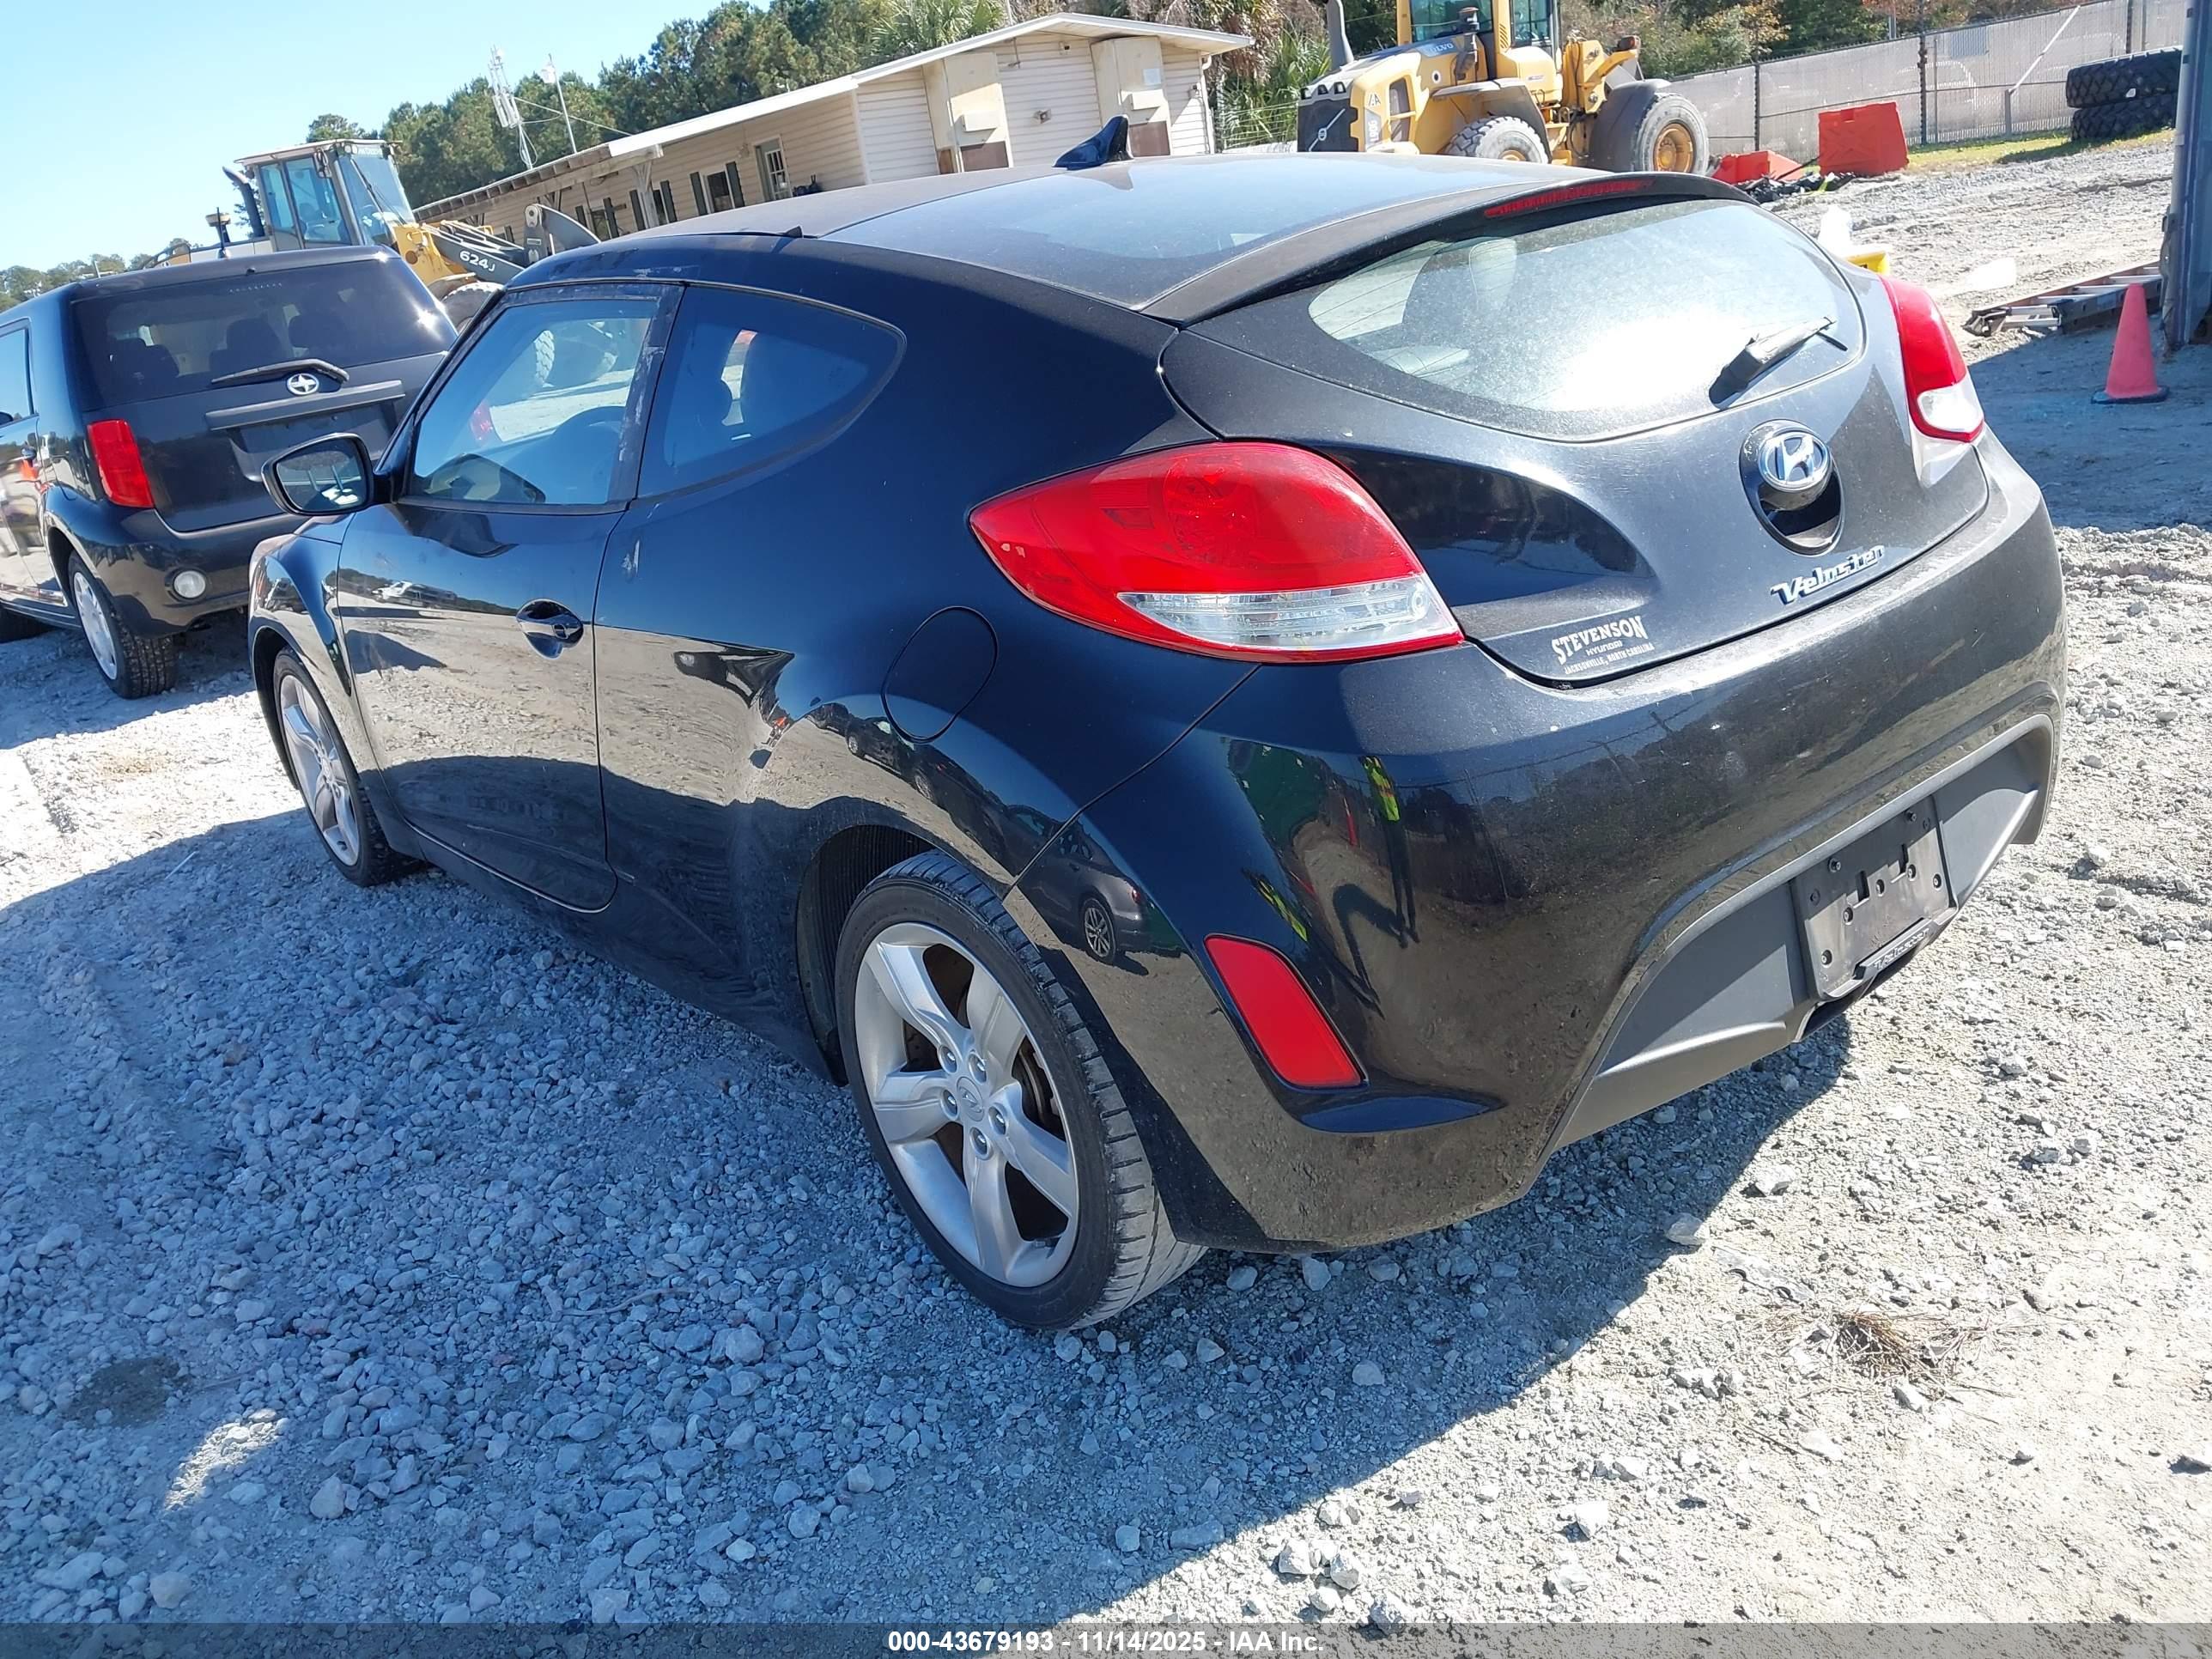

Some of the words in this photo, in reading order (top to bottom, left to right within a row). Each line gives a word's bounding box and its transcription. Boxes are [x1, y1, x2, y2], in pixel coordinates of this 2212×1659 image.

[459, 250, 495, 272] 624J
[1770, 544, 1885, 605] Veloster
[1552, 616, 1648, 665] STEVENSON
[1585, 640, 1623, 656] HYUNDAI
[1564, 656, 1609, 675] JACKSONVILLE,
[1607, 652, 1627, 663] NORTH
[1626, 642, 1656, 658] CAROLINA
